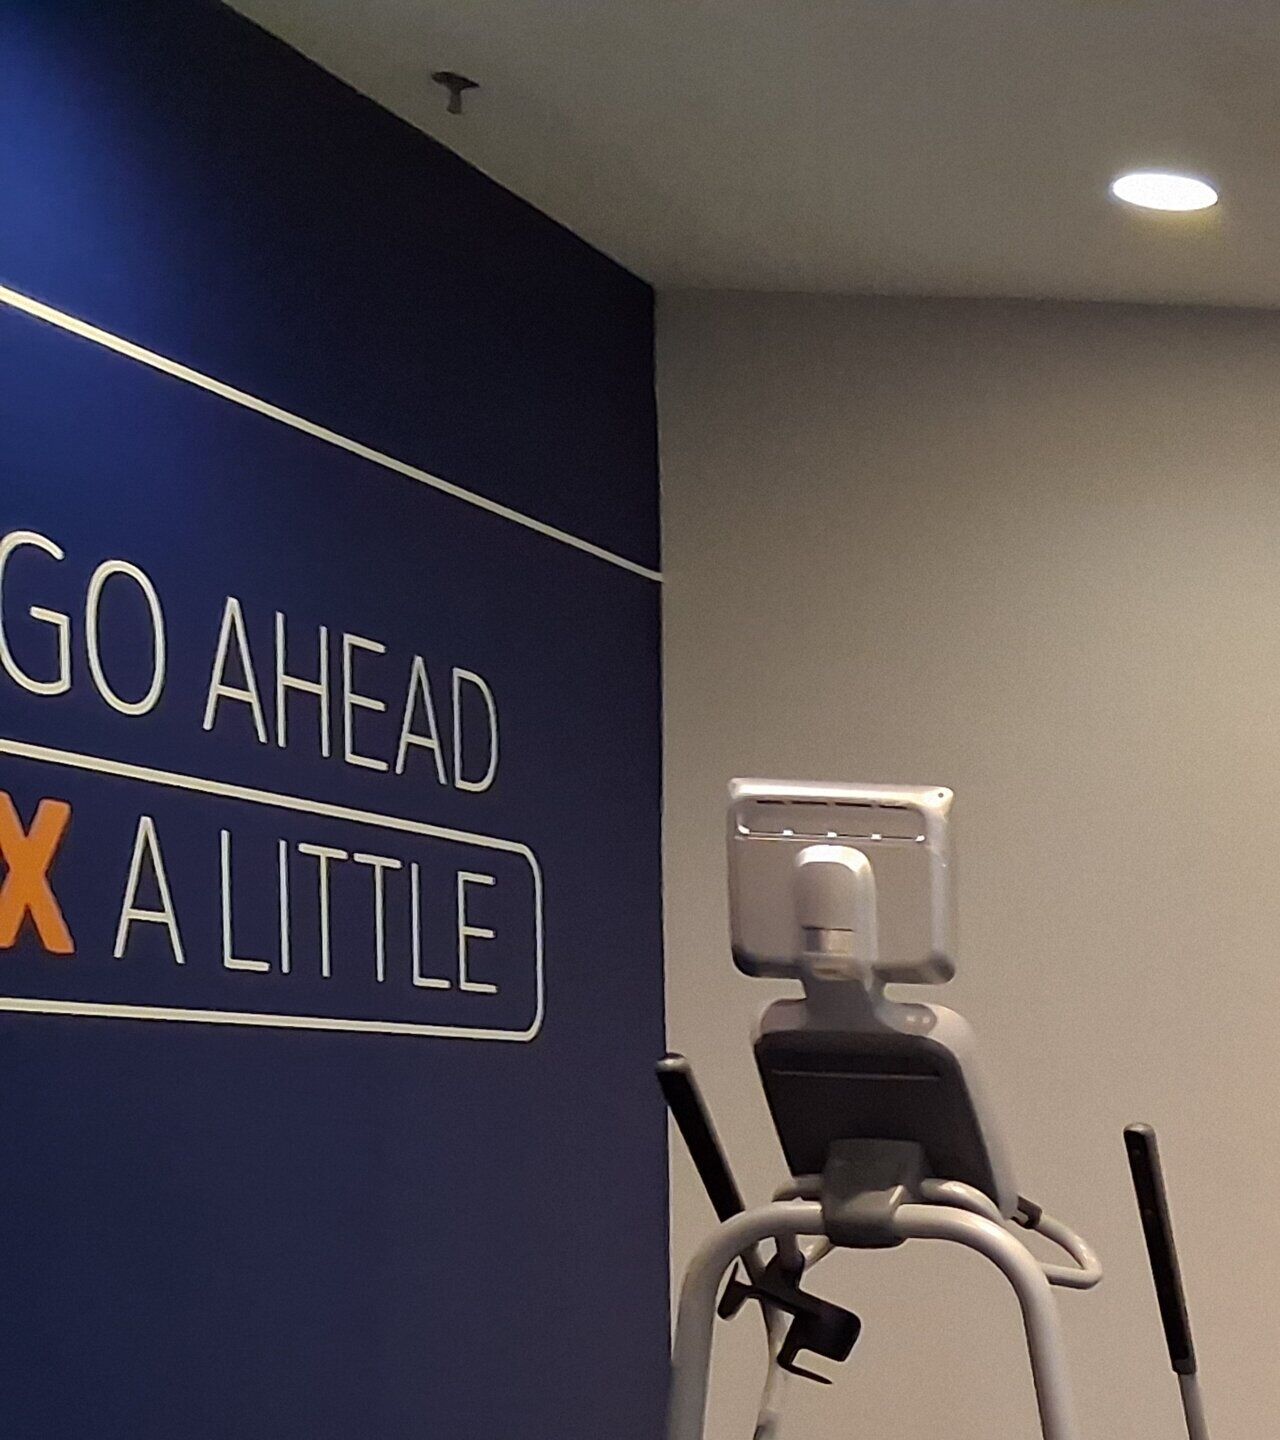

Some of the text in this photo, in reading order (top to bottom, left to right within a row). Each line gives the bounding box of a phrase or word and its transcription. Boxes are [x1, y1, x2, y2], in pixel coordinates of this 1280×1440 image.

[0, 531, 499, 792] GO AHEAD
[113, 816, 185, 964] A
[220, 830, 498, 993] LITTLE
